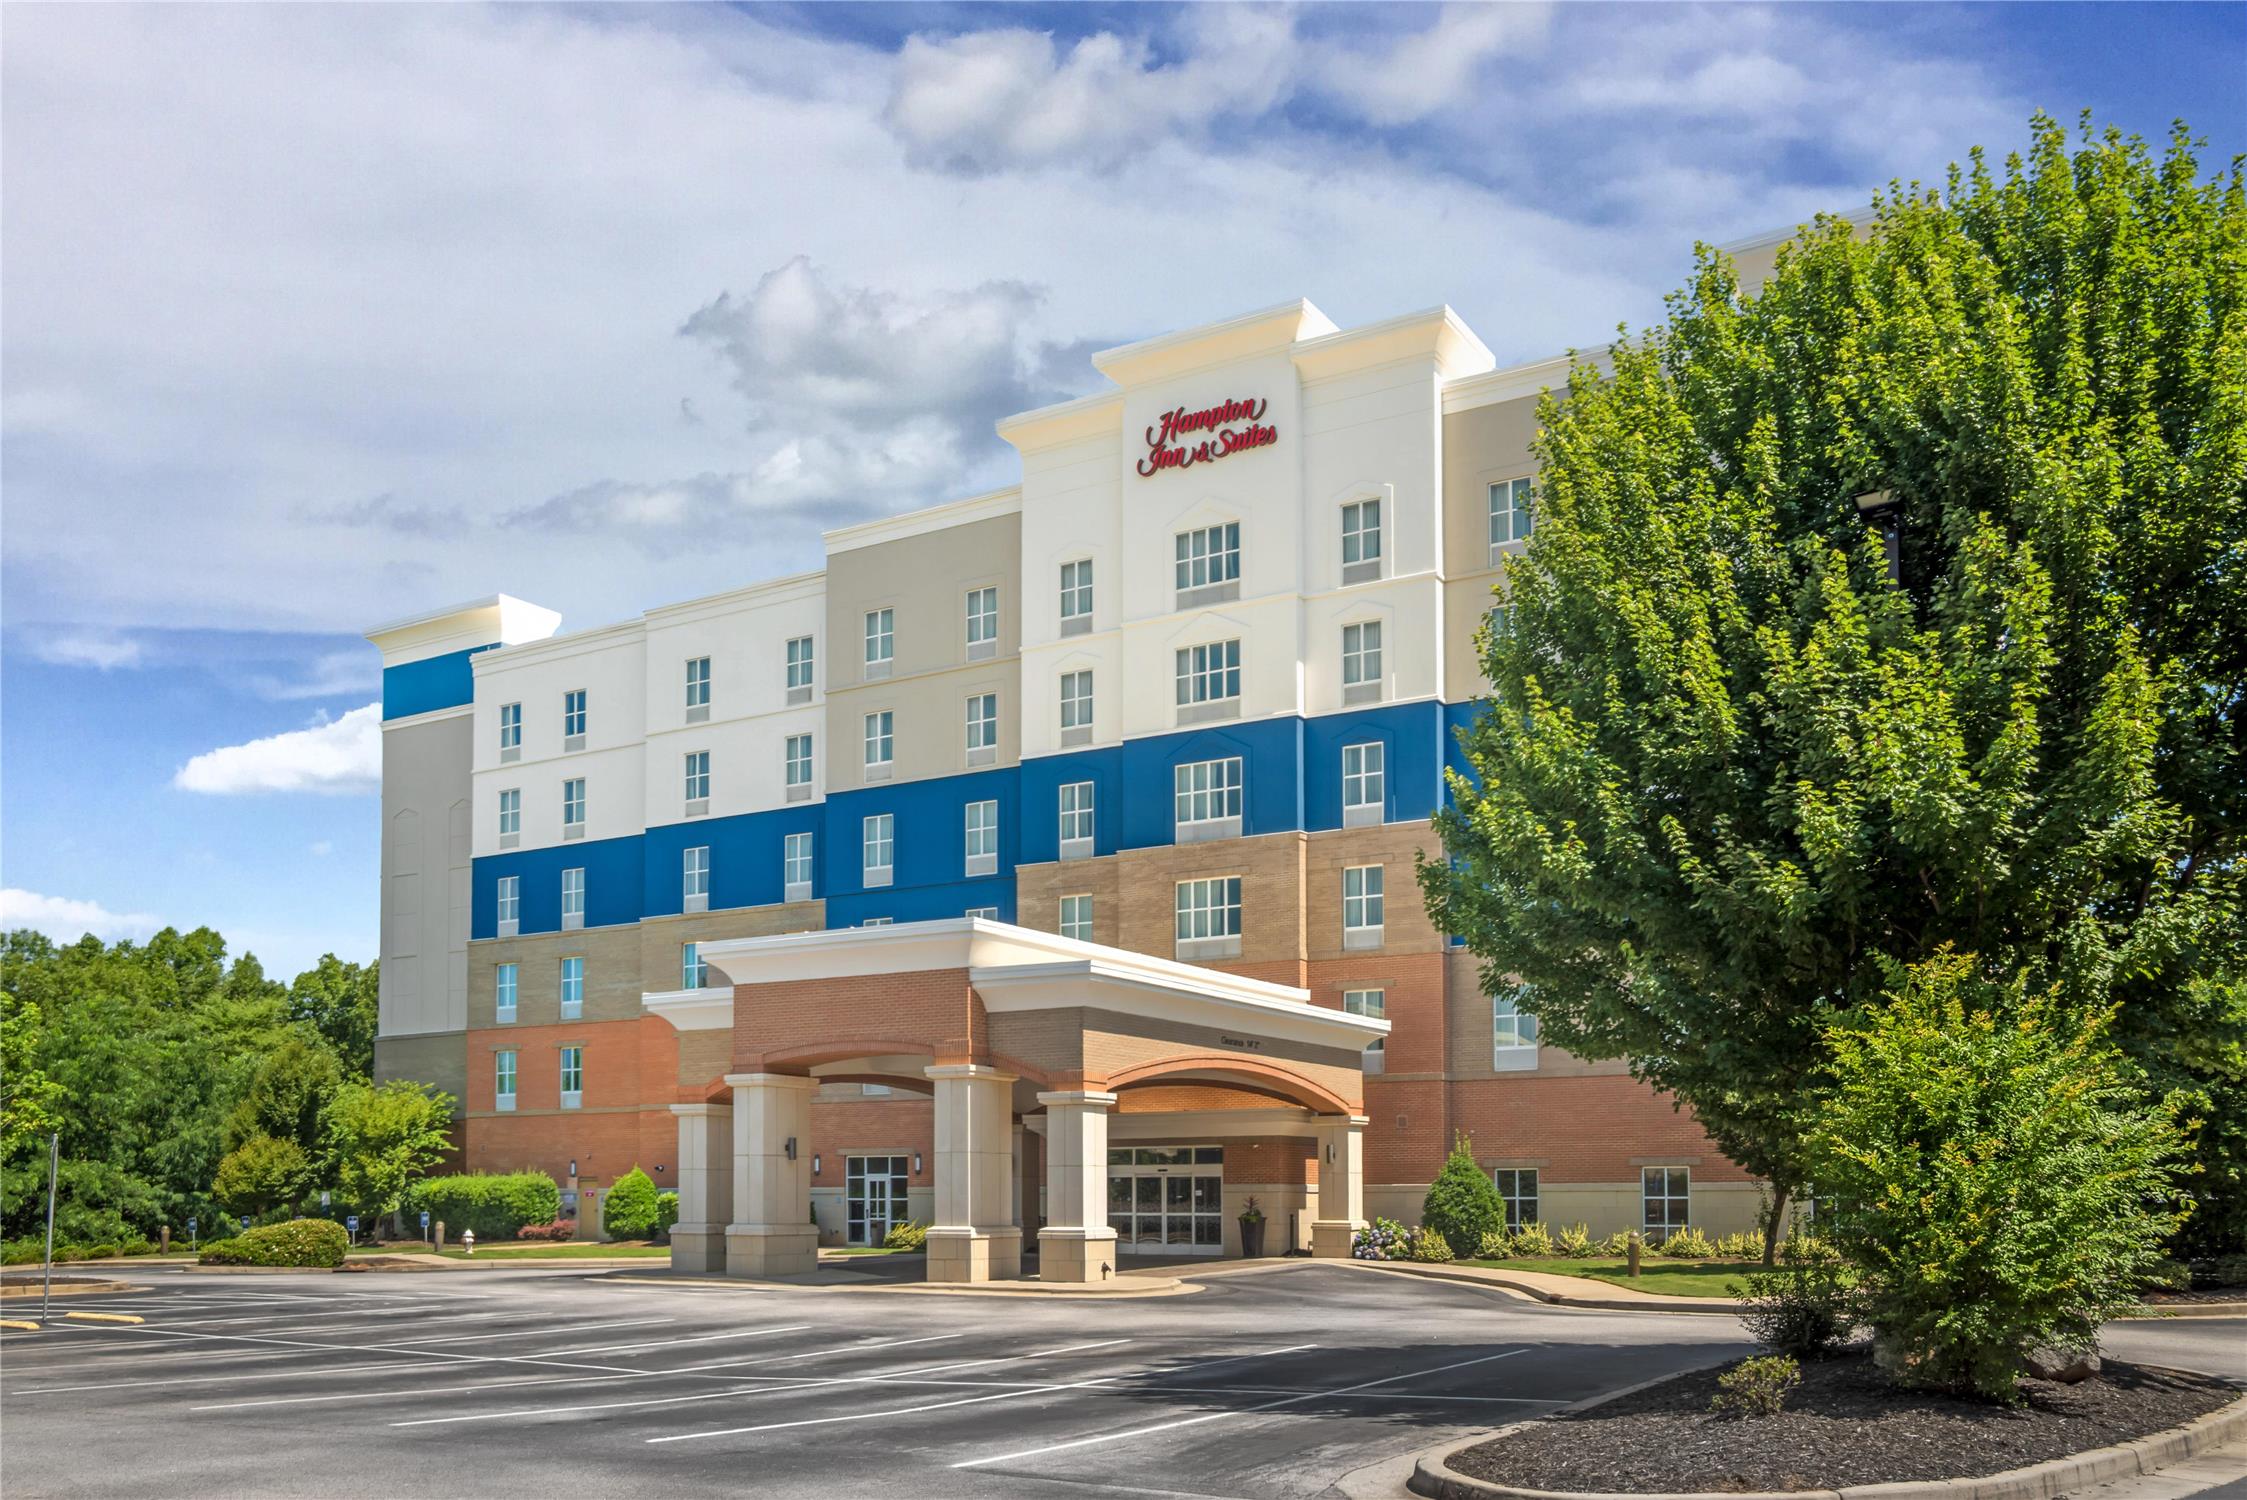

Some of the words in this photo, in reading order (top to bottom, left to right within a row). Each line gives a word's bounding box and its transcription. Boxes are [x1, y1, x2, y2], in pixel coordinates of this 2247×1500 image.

[1146, 398, 1267, 448] Hampton
[1137, 444, 1196, 478] Inn
[1194, 441, 1214, 463] &
[1210, 423, 1278, 458] Suites
